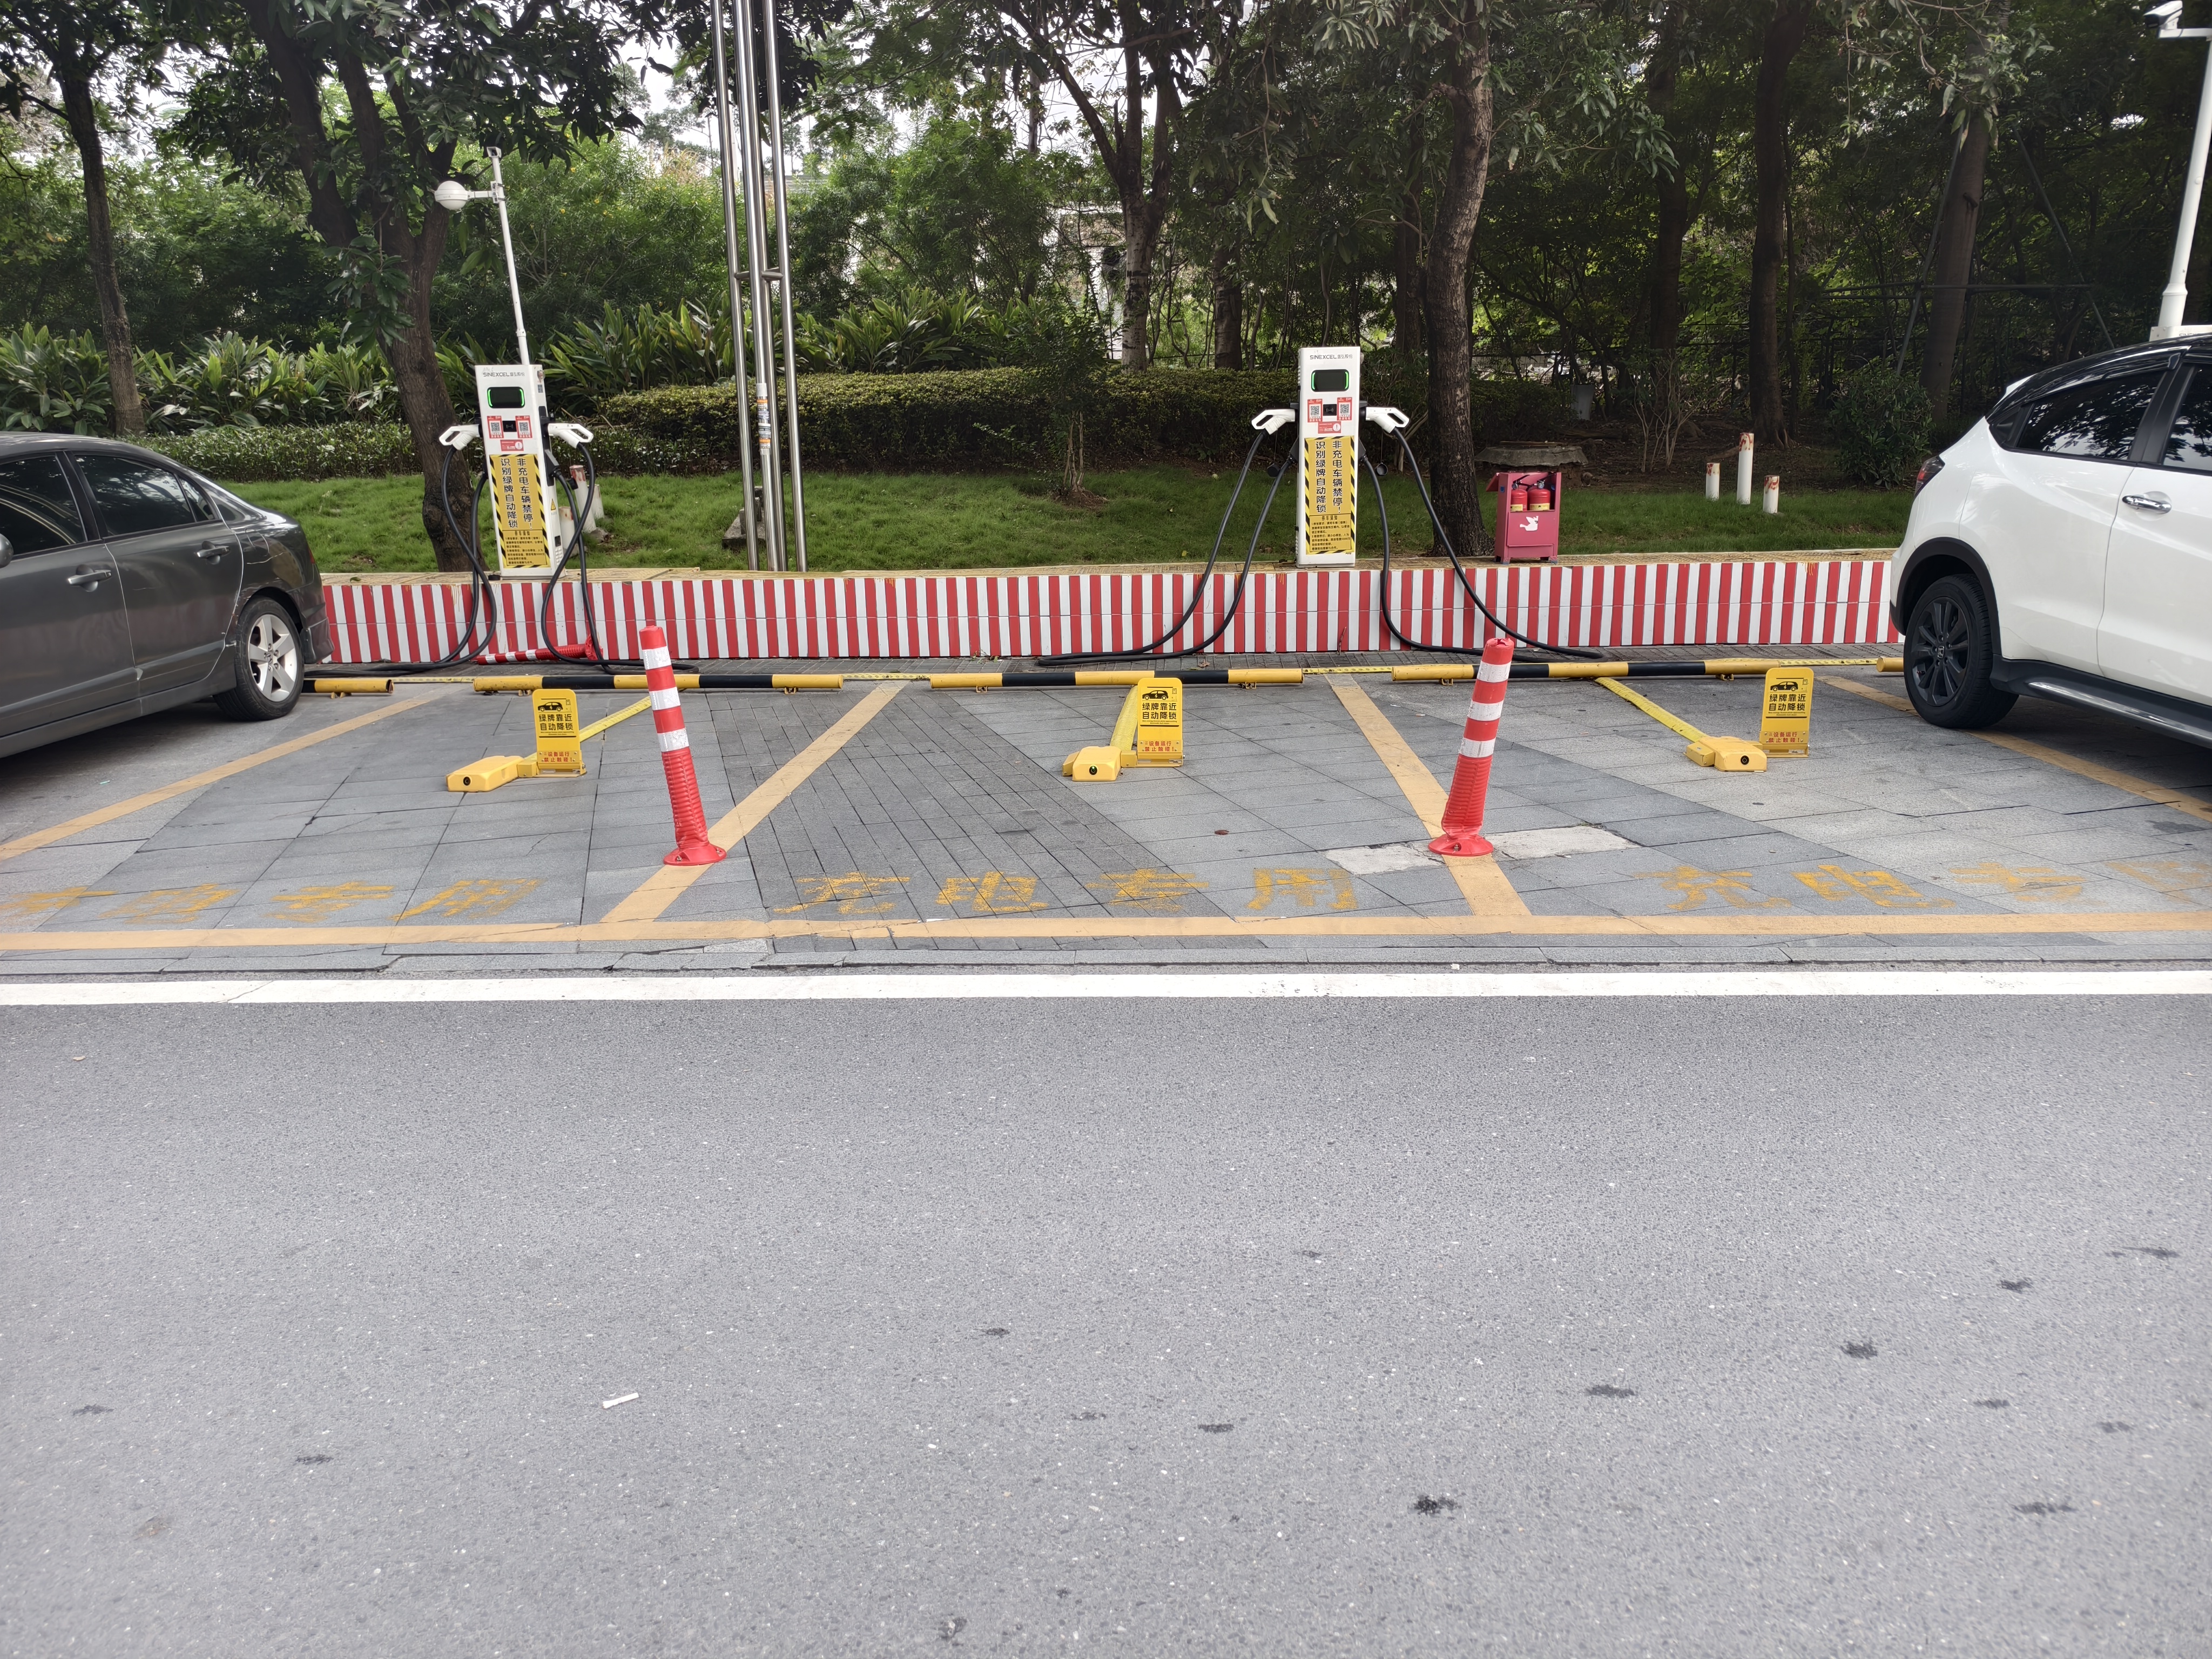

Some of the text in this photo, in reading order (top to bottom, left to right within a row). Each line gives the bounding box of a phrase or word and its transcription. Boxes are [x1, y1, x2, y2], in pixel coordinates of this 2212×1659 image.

[1315, 441, 1326, 513] 识别绿牌自动降锁
[1332, 440, 1343, 514] 非充电车辆禁停！
[501, 458, 518, 528] 识别绿牌自动降锁
[517, 458, 534, 529] 非充电车辆禁停！
[1769, 693, 1806, 702] 绿牌靠近
[1142, 702, 1177, 711] 绿牌靠近
[1769, 703, 1805, 711] 自动降锁
[538, 713, 572, 722] 绿牌靠近
[1142, 711, 1177, 720] 自动降锁
[540, 723, 574, 731] 自动降锁
[773, 867, 1359, 915] 充电专用
